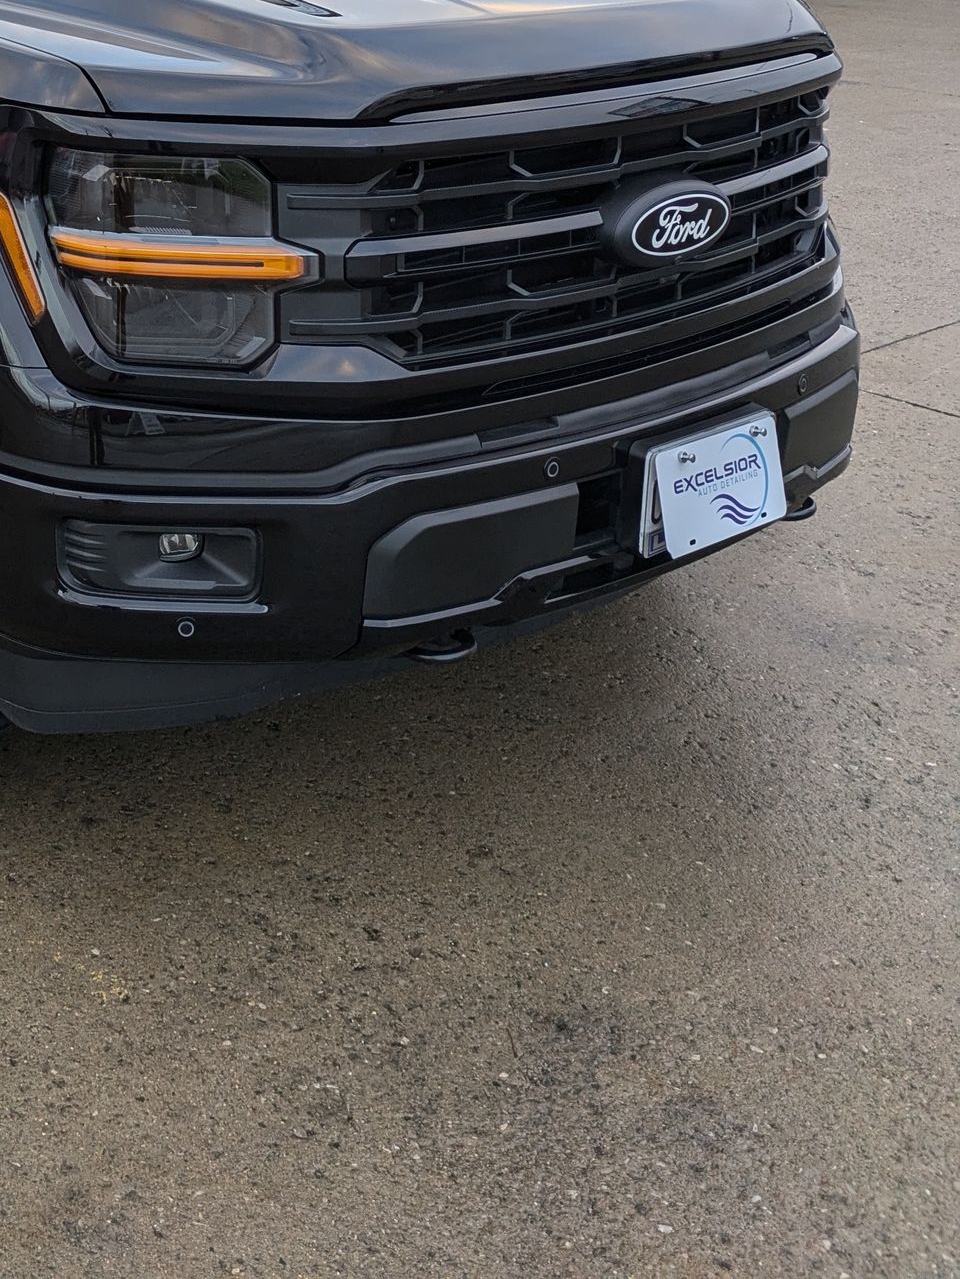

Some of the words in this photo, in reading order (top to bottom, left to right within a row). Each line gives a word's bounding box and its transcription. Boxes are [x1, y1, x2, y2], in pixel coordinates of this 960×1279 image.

[652, 203, 712, 248] Ford
[673, 453, 761, 495] EXCELSIOR
[698, 484, 718, 497] AUTO
[721, 469, 758, 489] DETAILING
